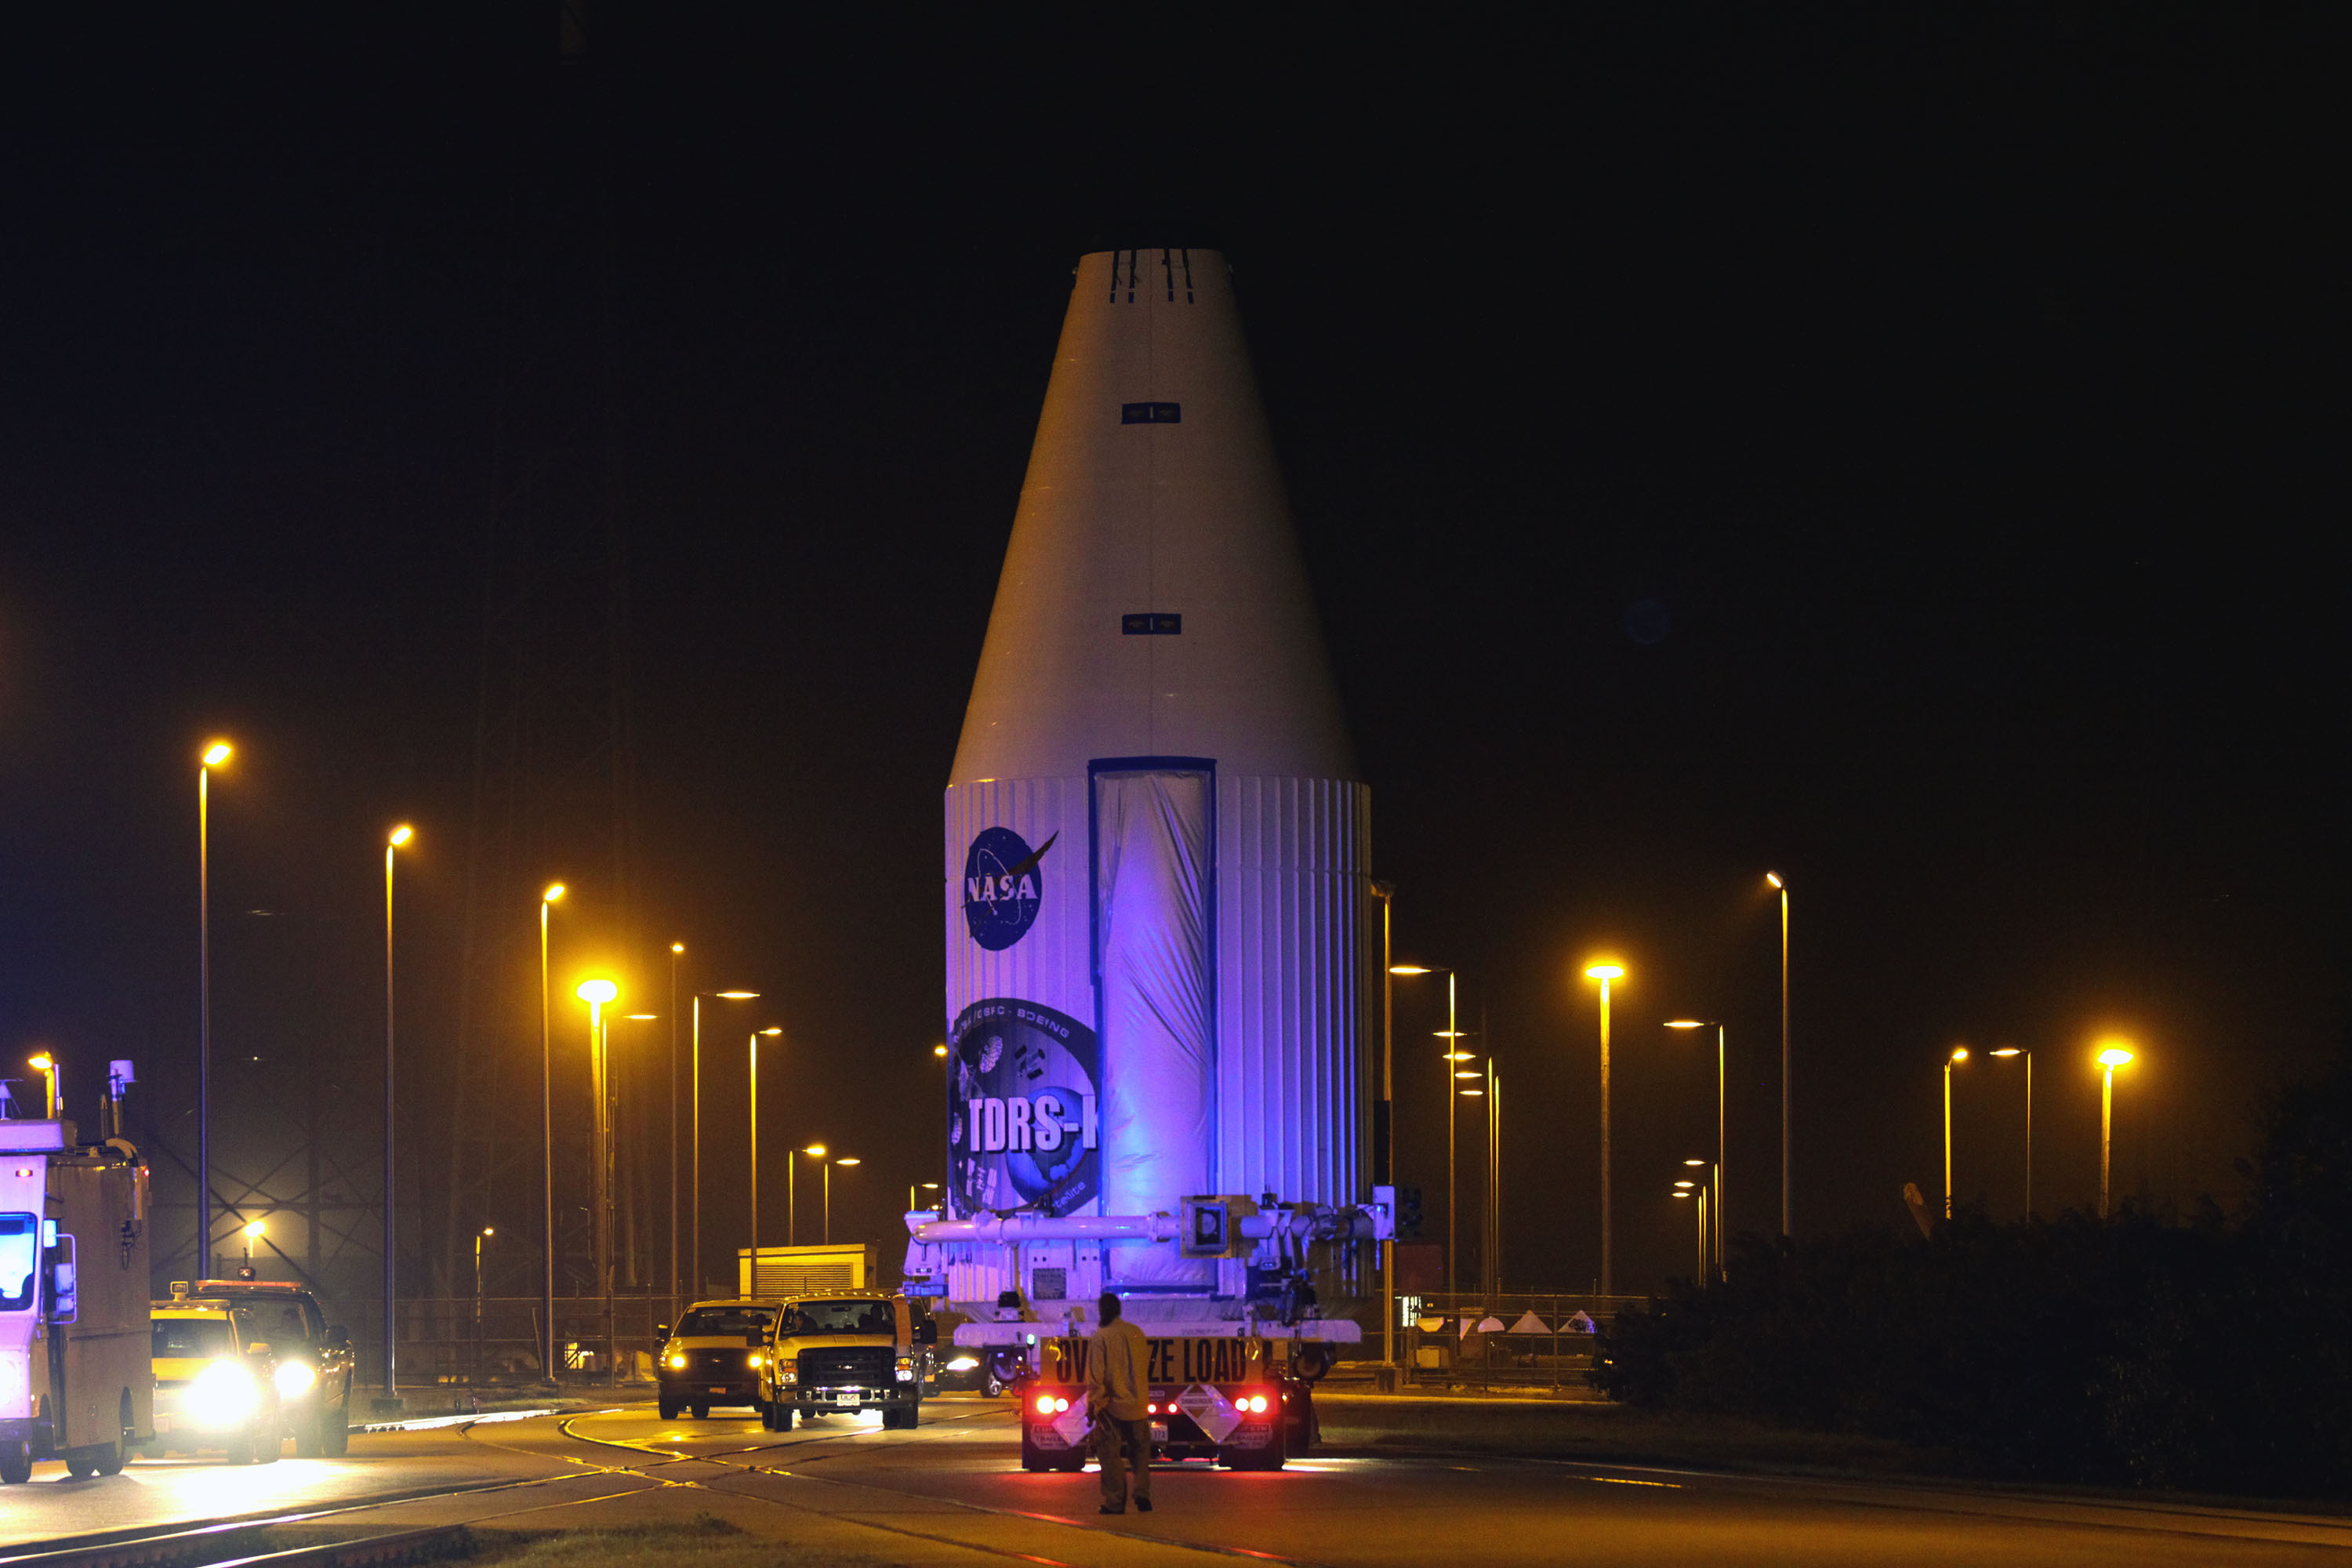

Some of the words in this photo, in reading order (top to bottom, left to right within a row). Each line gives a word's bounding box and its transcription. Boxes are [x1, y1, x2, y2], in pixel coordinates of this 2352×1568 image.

[967, 874, 1038, 902] NASA
[1017, 1008, 1070, 1038] BOEING
[1057, 1339, 1174, 1383] OVZE
[1184, 1339, 1247, 1382] LOAD
